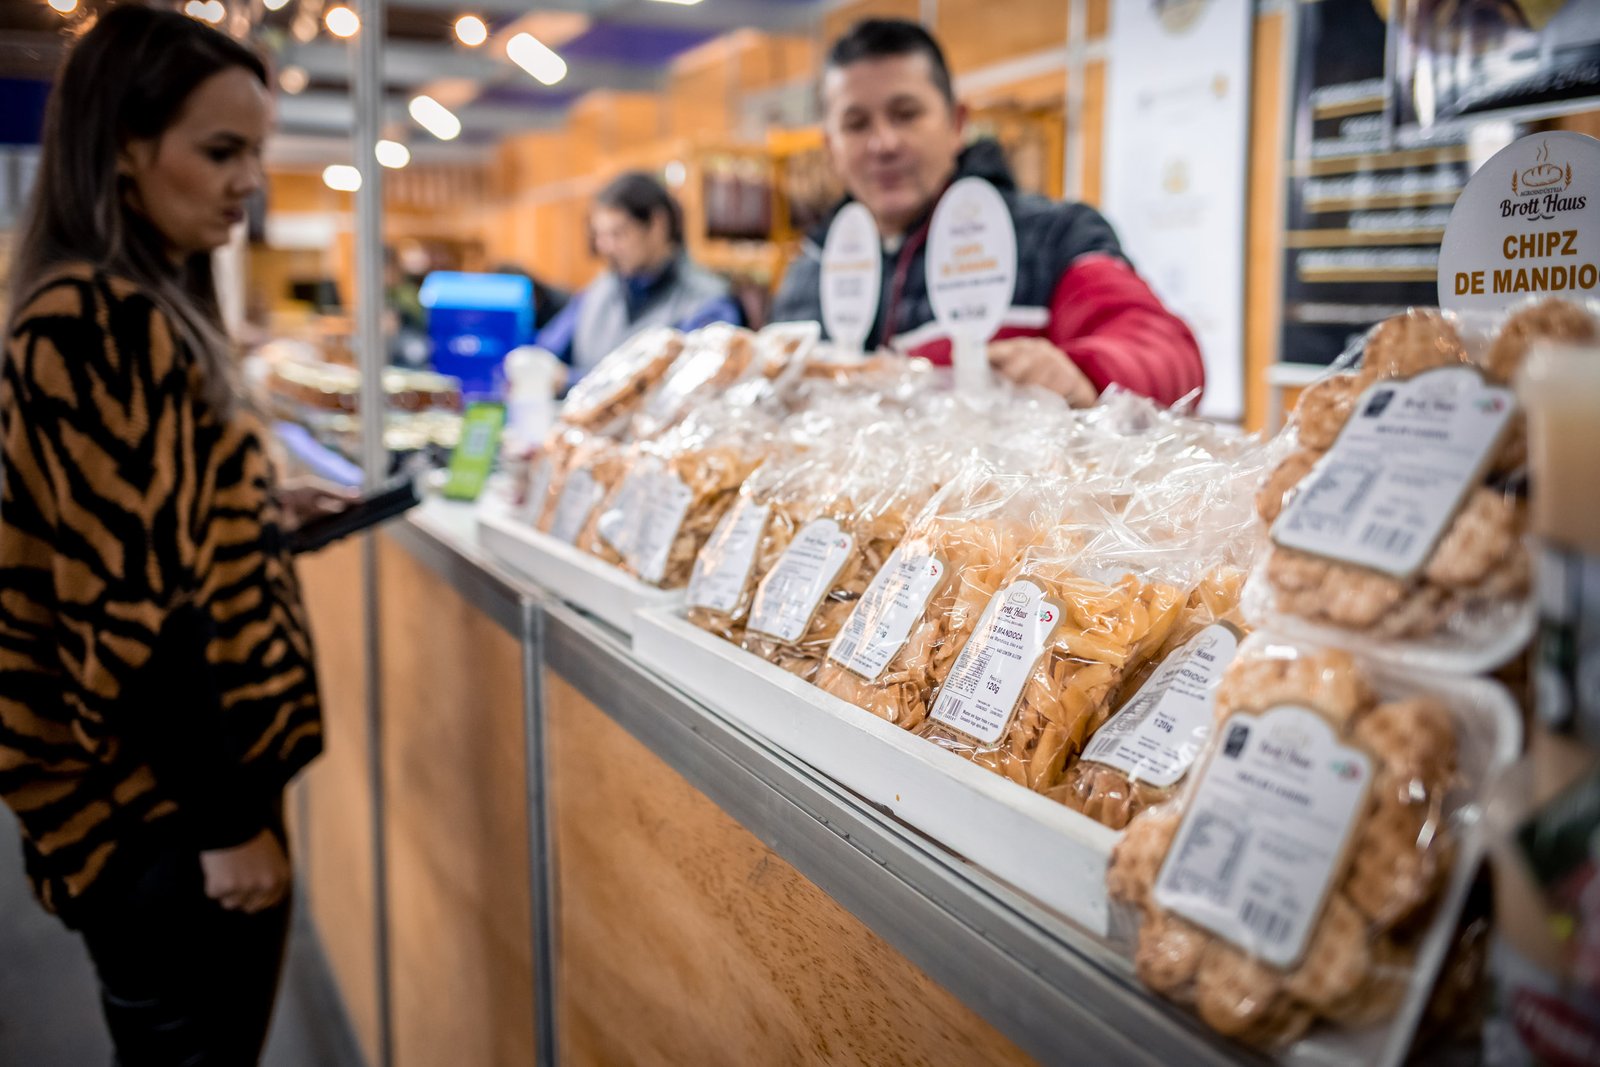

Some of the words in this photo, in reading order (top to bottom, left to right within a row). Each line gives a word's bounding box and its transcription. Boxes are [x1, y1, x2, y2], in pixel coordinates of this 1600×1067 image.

[1500, 198, 1539, 217] Brott
[1543, 193, 1586, 213] Haus
[1503, 230, 1578, 260] CHIPZ
[1455, 271, 1485, 295] DE
[1493, 264, 1600, 293] MANDIO
[986, 681, 1000, 695] 120g
